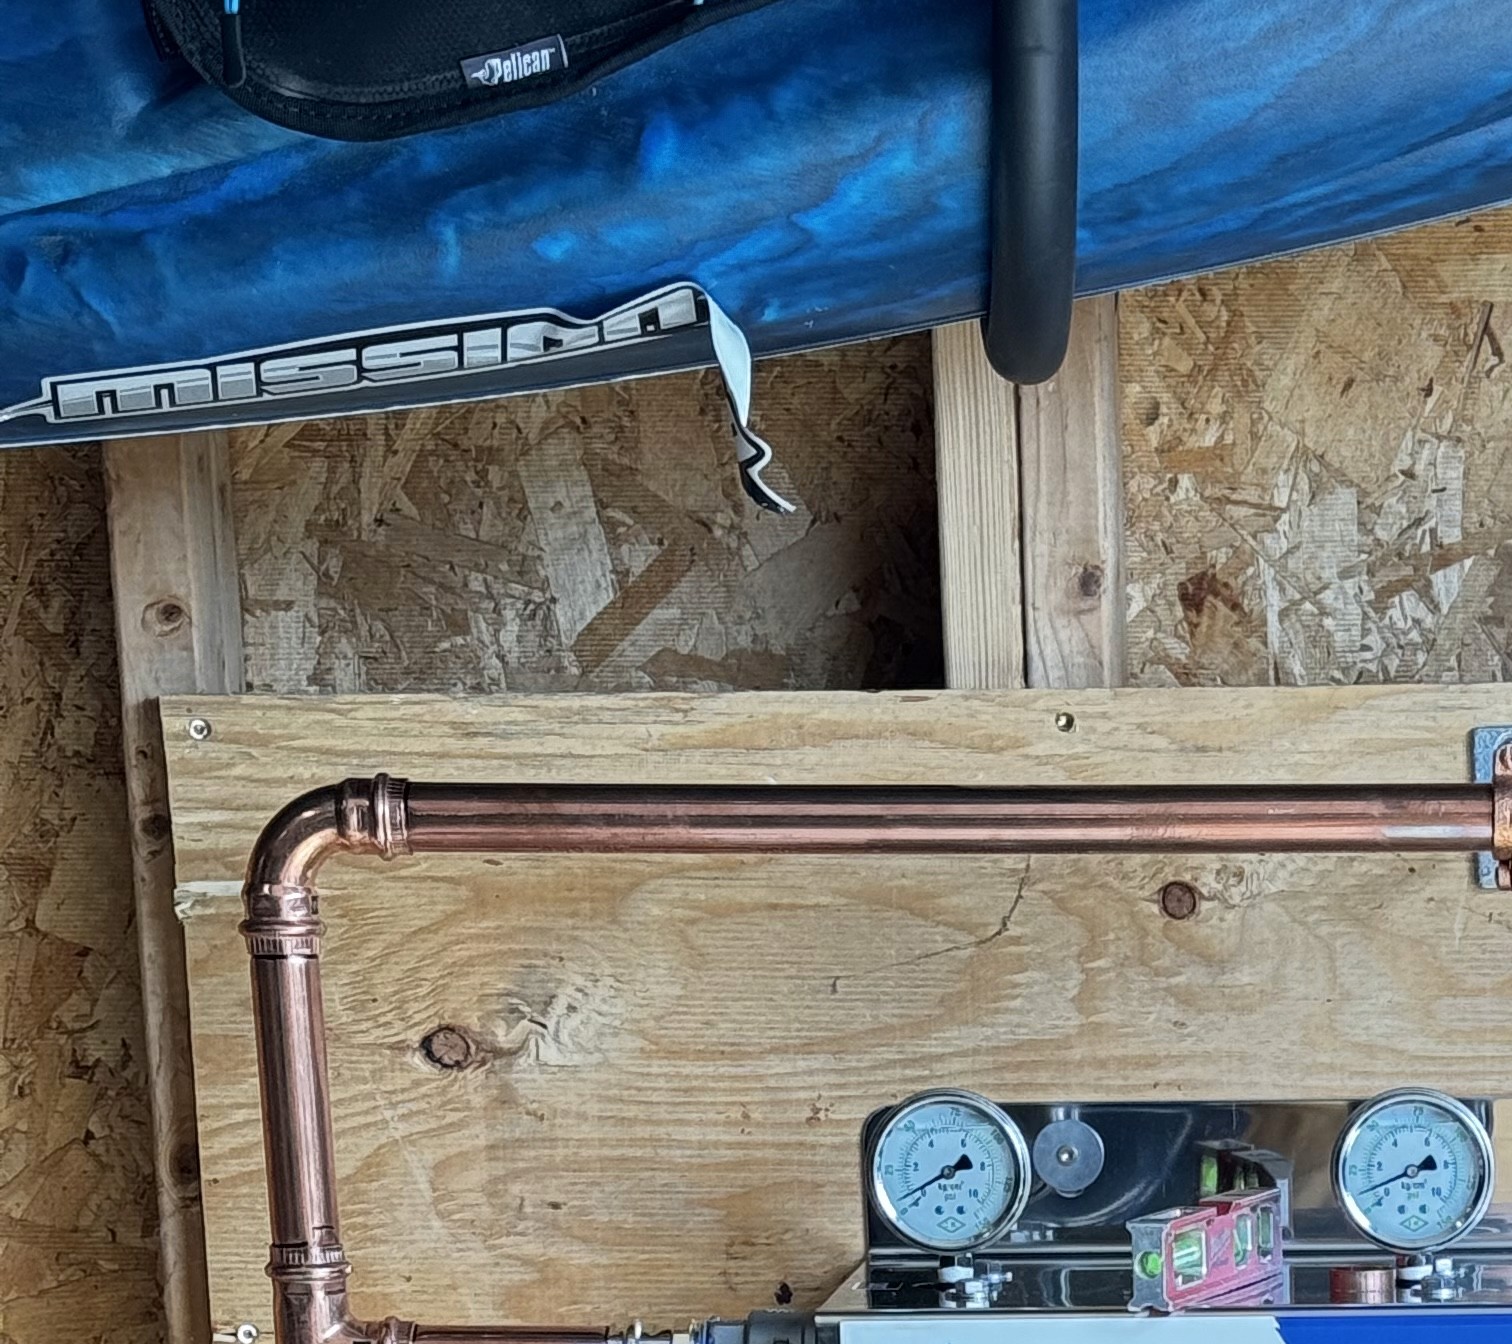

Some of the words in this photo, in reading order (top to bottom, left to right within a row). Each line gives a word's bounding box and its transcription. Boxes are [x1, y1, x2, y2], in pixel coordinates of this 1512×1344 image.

[479, 48, 555, 86] Pelican
[56, 288, 698, 419] mission
[928, 1139, 934, 1148] 4
[961, 1139, 966, 1148] 6
[1392, 1139, 1398, 1148] 4
[1425, 1137, 1430, 1146] 6
[913, 1162, 919, 1171] 2
[1377, 1162, 1383, 1171] 2
[969, 1189, 978, 1198] 10
[1384, 1187, 1389, 1197] 0
[1431, 1187, 1441, 1197] 10
